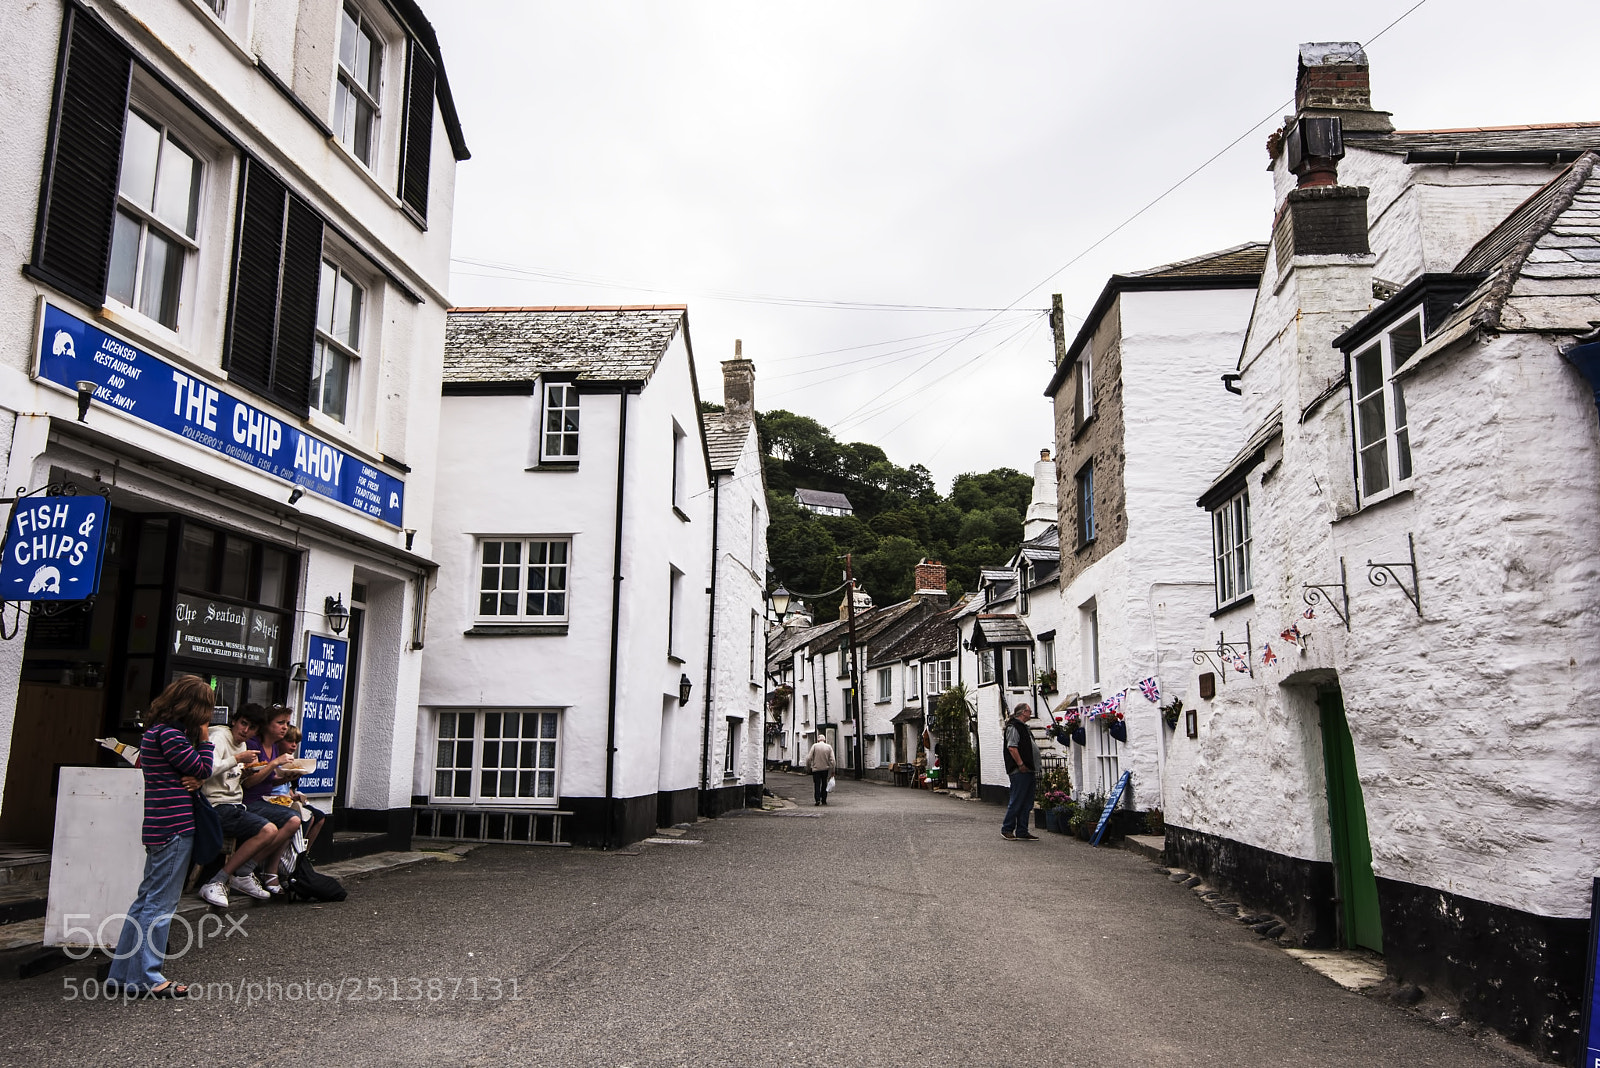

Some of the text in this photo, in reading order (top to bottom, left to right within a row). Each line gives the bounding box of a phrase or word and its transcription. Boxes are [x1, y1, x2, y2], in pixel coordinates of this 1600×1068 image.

[102, 338, 137, 361] LICENSED
[93, 351, 142, 380] RESTAURANT
[107, 374, 125, 389] AND
[93, 385, 136, 411] AKE-AWAY
[172, 370, 344, 486] THE CHIP AHOY
[181, 425, 223, 450] POLPERRO'S
[225, 444, 255, 464] ORIGINAL
[257, 457, 272, 470] FISH
[273, 465, 278, 474] &
[280, 468, 294, 480] CHIP
[295, 474, 315, 489] EATING
[358, 475, 380, 492] FOR FRESH
[355, 485, 381, 504] TRADITIONAL
[352, 497, 382, 516] FISH & CHIPS
[16, 504, 69, 536] FISH
[78, 512, 96, 537] &
[14, 534, 88, 566] CHIPS
[176, 602, 279, 639] The Seafood Shelf
[184, 634, 201, 644] FRESH
[214, 648, 231, 657] JELLIED
[232, 651, 243, 659] EELS
[247, 653, 260, 661] CRAB
[322, 643, 335, 660] THE
[308, 658, 344, 680] CHIP AHOY
[303, 701, 341, 721] FISH & CHIPS
[307, 731, 334, 743] FINE FOODS
[304, 749, 333, 760] SCRUMPY ALES
[321, 777, 334, 787] MEALS
